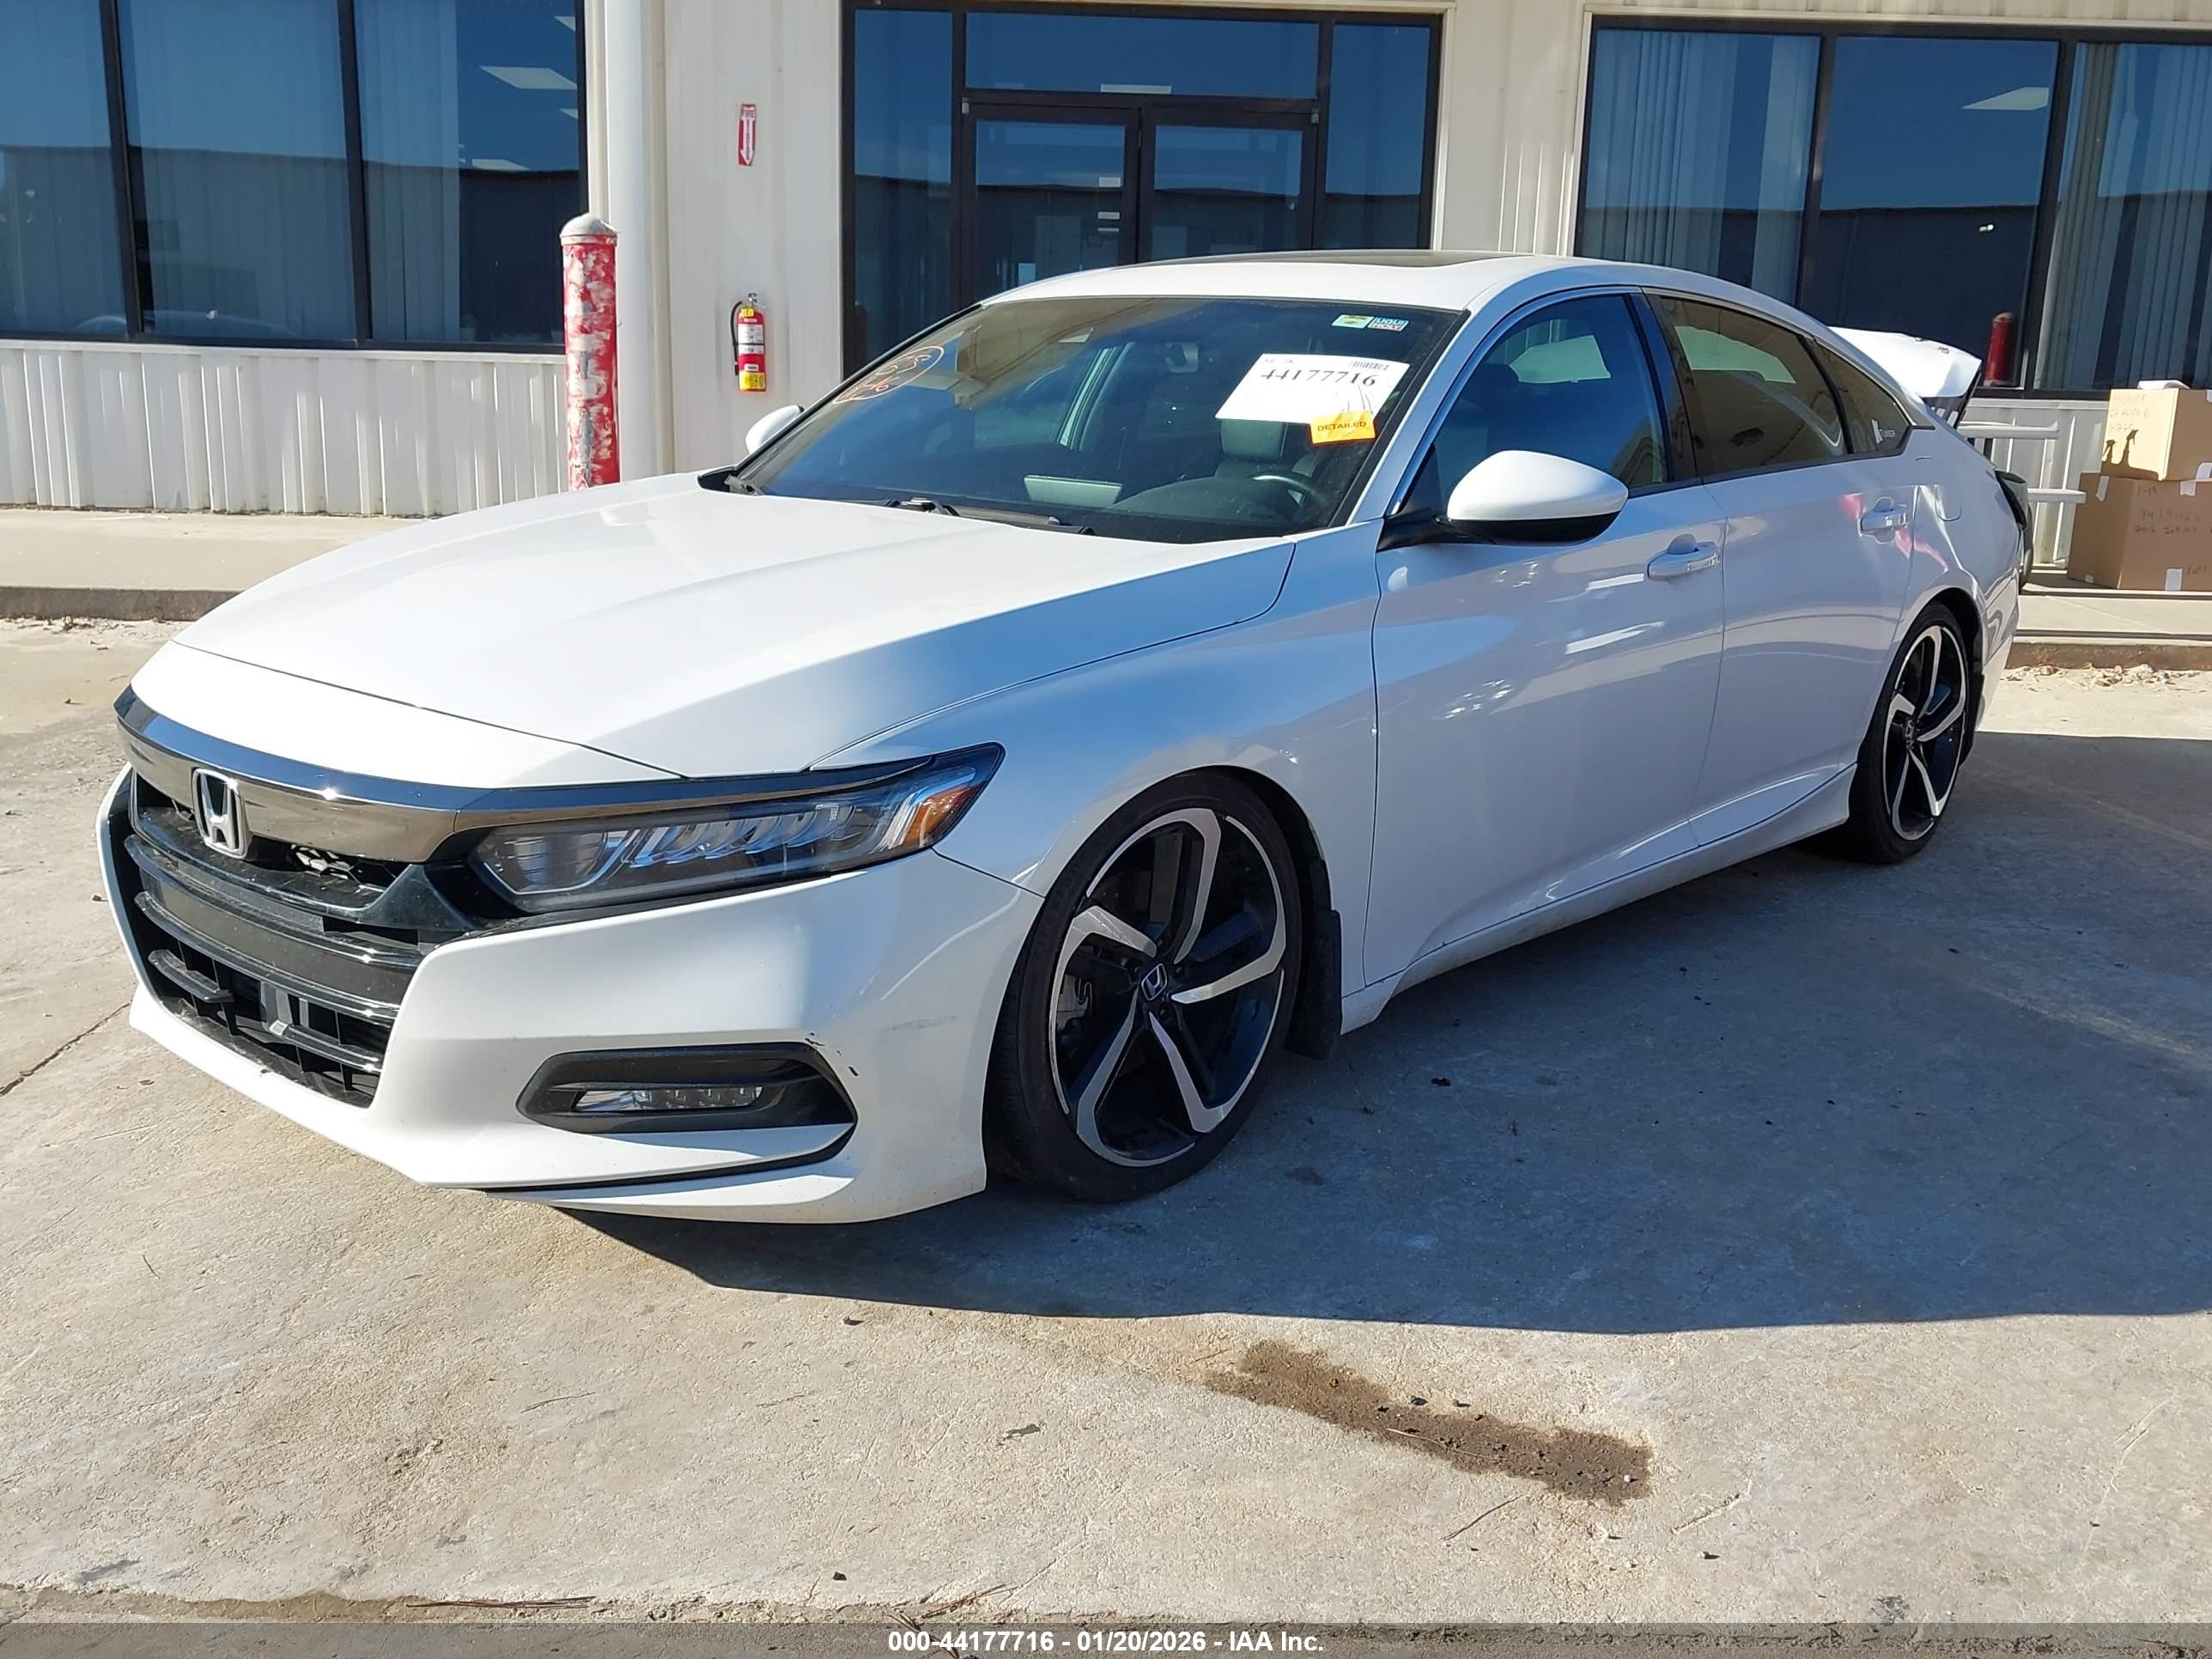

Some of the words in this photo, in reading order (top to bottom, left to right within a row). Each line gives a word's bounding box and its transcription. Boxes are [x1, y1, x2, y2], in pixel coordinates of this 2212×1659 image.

[1374, 317, 1407, 325] LIQUI
[1261, 369, 1379, 386] 44177716
[1317, 421, 1367, 432] DETAILED
